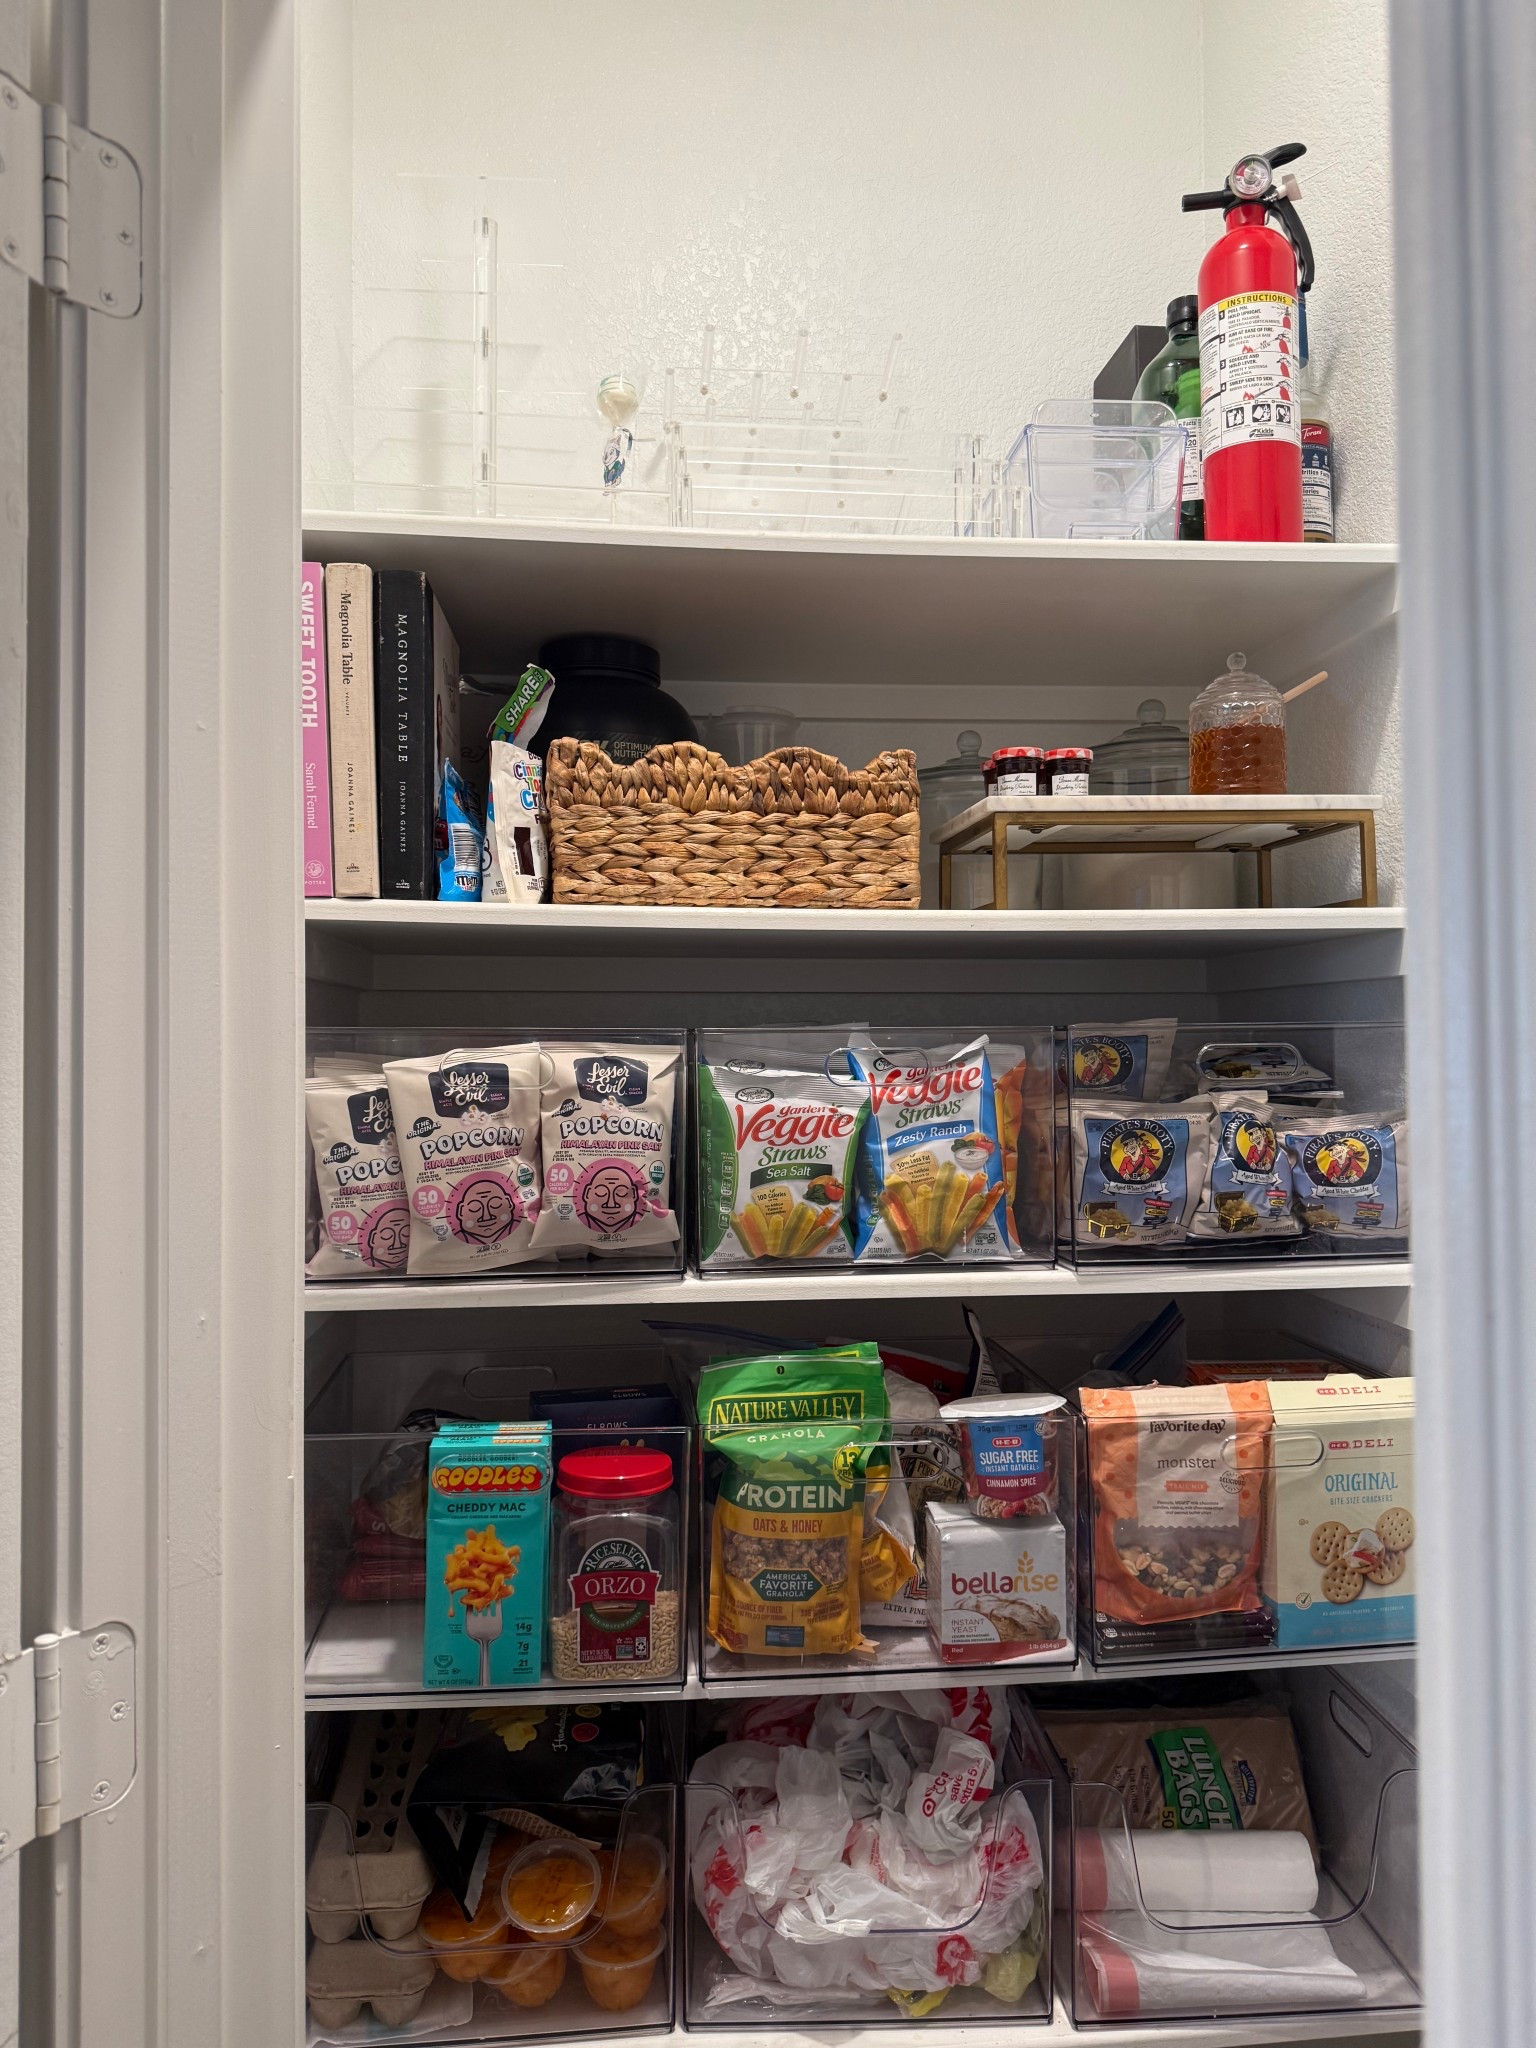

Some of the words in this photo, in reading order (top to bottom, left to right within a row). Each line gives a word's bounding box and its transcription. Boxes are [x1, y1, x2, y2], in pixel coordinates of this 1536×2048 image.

[1227, 294, 1287, 307] INSTRUCTIONS
[1302, 427, 1323, 440] Torani
[302, 581, 315, 649] SWEET
[339, 593, 353, 649] Magnolia
[397, 614, 408, 702] MAGNOLIA
[342, 652, 354, 685] Table
[302, 658, 318, 727] TOOTH
[505, 675, 541, 727] SHARE
[398, 713, 408, 762] TABLE
[614, 741, 651, 752] OPTIMUM
[614, 750, 648, 759] NUTRIT
[305, 762, 317, 792] Sarah
[307, 795, 318, 829] Fennel
[1102, 1037, 1131, 1058] BOOTY
[587, 1062, 630, 1084] Lesser
[444, 1071, 490, 1096] Lesser
[596, 1077, 626, 1096] Evil
[868, 1062, 984, 1115] Veggie
[456, 1087, 489, 1105] Evil
[777, 1105, 826, 1117] garden
[895, 1099, 962, 1129] Straws
[407, 1122, 442, 1139] ORIGINAL
[416, 1120, 430, 1128] THE
[560, 1116, 664, 1141] POPCORN
[735, 1104, 855, 1152] Veggie
[420, 1127, 524, 1160] POPCORN
[895, 1131, 927, 1148] Zesty
[930, 1124, 967, 1138] Ranch
[1102, 1120, 1141, 1148] PIRATE'S
[1144, 1121, 1173, 1149] BOOTY
[334, 1146, 347, 1154] THE
[561, 1140, 618, 1149] HIMALAYAN
[618, 1140, 641, 1150] PINK
[641, 1142, 663, 1151] SALT
[1305, 1133, 1341, 1158] PIRATE'S
[323, 1147, 359, 1164] ORIGINAL
[424, 1154, 484, 1170] HIMALAYAN
[484, 1152, 505, 1162] PINK
[758, 1145, 828, 1167] Straws
[336, 1156, 403, 1186] POPC
[550, 1168, 568, 1182] 50
[767, 1168, 787, 1178] Sea
[790, 1166, 811, 1177] Salt
[340, 1182, 399, 1196] HIMALAYAN
[418, 1190, 438, 1205] 50
[331, 1216, 351, 1231] 50
[1340, 1386, 1382, 1395] DELI
[716, 1401, 787, 1434] NATURE
[790, 1397, 855, 1421] VALLEY
[747, 1428, 825, 1443] GRANOLA
[977, 1425, 991, 1433] 35g
[1150, 1420, 1200, 1433] favorite
[1201, 1419, 1226, 1434] day
[1352, 1438, 1394, 1449] DELI
[980, 1451, 1014, 1465] SUGAR
[1016, 1450, 1039, 1463] FREE
[1157, 1458, 1216, 1468] monster
[986, 1478, 1019, 1488] CINNAMON
[1020, 1477, 1037, 1486] SPICE
[1325, 1472, 1398, 1492] ORIGINAL
[736, 1483, 845, 1509] PROTEIN
[1331, 1497, 1343, 1505] BITE
[1346, 1496, 1359, 1504] SIZE
[1362, 1495, 1393, 1504] CRACKERS
[447, 1503, 496, 1513] CHEDDY
[499, 1503, 526, 1511] MAC
[754, 1518, 777, 1532] OATS
[780, 1519, 788, 1532] &
[791, 1519, 823, 1533] HONEY
[585, 1542, 645, 1569] RICESELECT
[584, 1576, 646, 1596] ORZO
[760, 1580, 814, 1590] FAVORITE
[766, 1573, 808, 1581] AMERICA'S
[952, 1571, 1059, 1595] bellarise
[766, 1605, 783, 1613] FIBER
[883, 1603, 907, 1615] EXTRA
[909, 1606, 926, 1616] FINE
[516, 1623, 532, 1632] 14g
[951, 1618, 984, 1627] INSTANT
[517, 1641, 529, 1651] 7g
[519, 1659, 528, 1667] 21
[951, 1775, 963, 1802] save
[960, 1778, 976, 1804] extra
[1164, 1749, 1204, 1826] BAGS
[1181, 1736, 1234, 1829] LUNCH
[1161, 1809, 1175, 1829] 50
